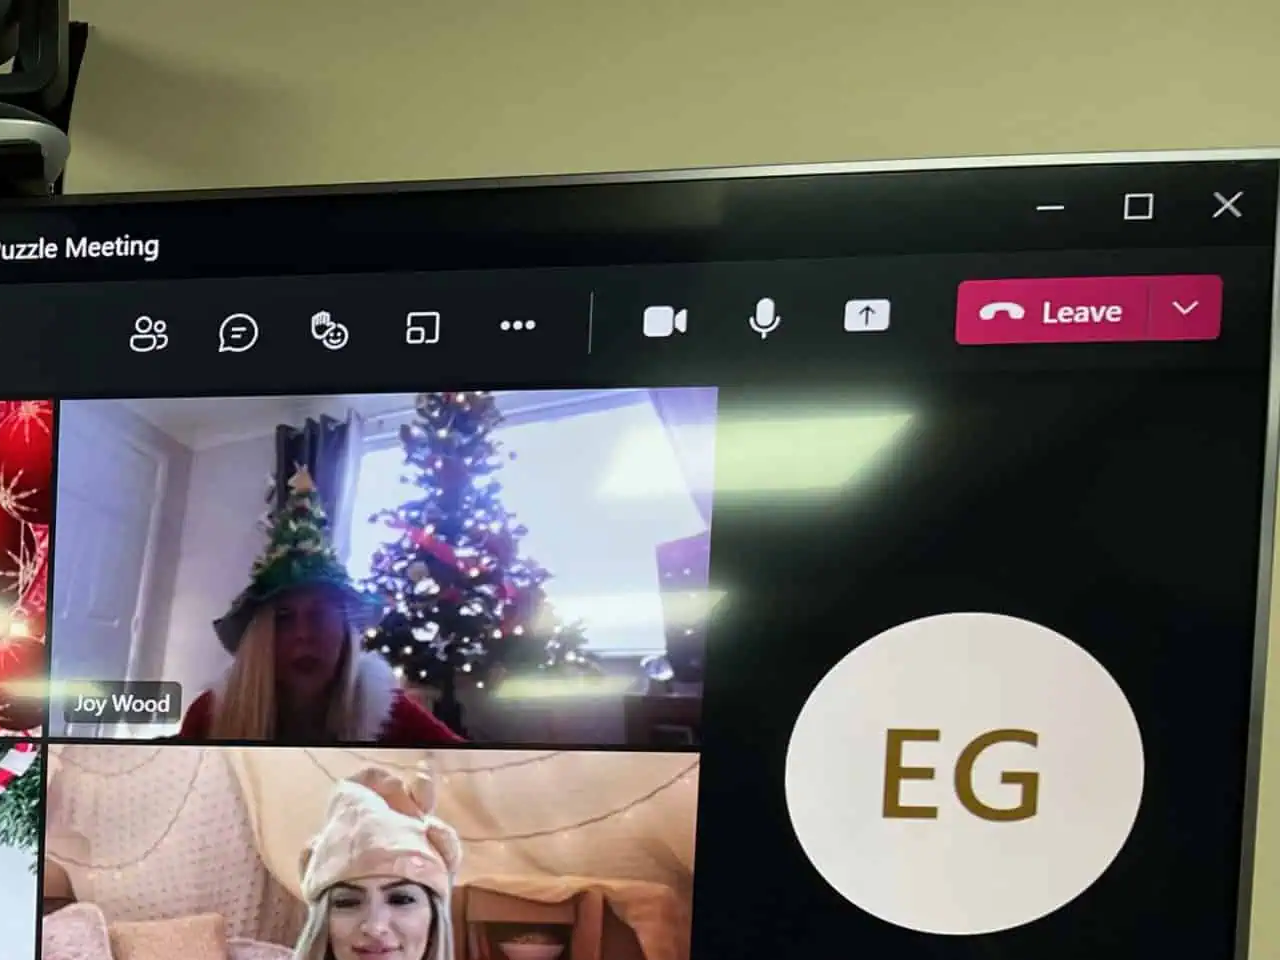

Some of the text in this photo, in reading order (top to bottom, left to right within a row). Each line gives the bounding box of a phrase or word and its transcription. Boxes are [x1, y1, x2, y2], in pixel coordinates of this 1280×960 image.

[65, 234, 159, 262] Meeting
[1043, 300, 1123, 325] Leave
[73, 692, 170, 717] Joy Wood
[882, 727, 1040, 823] EG
